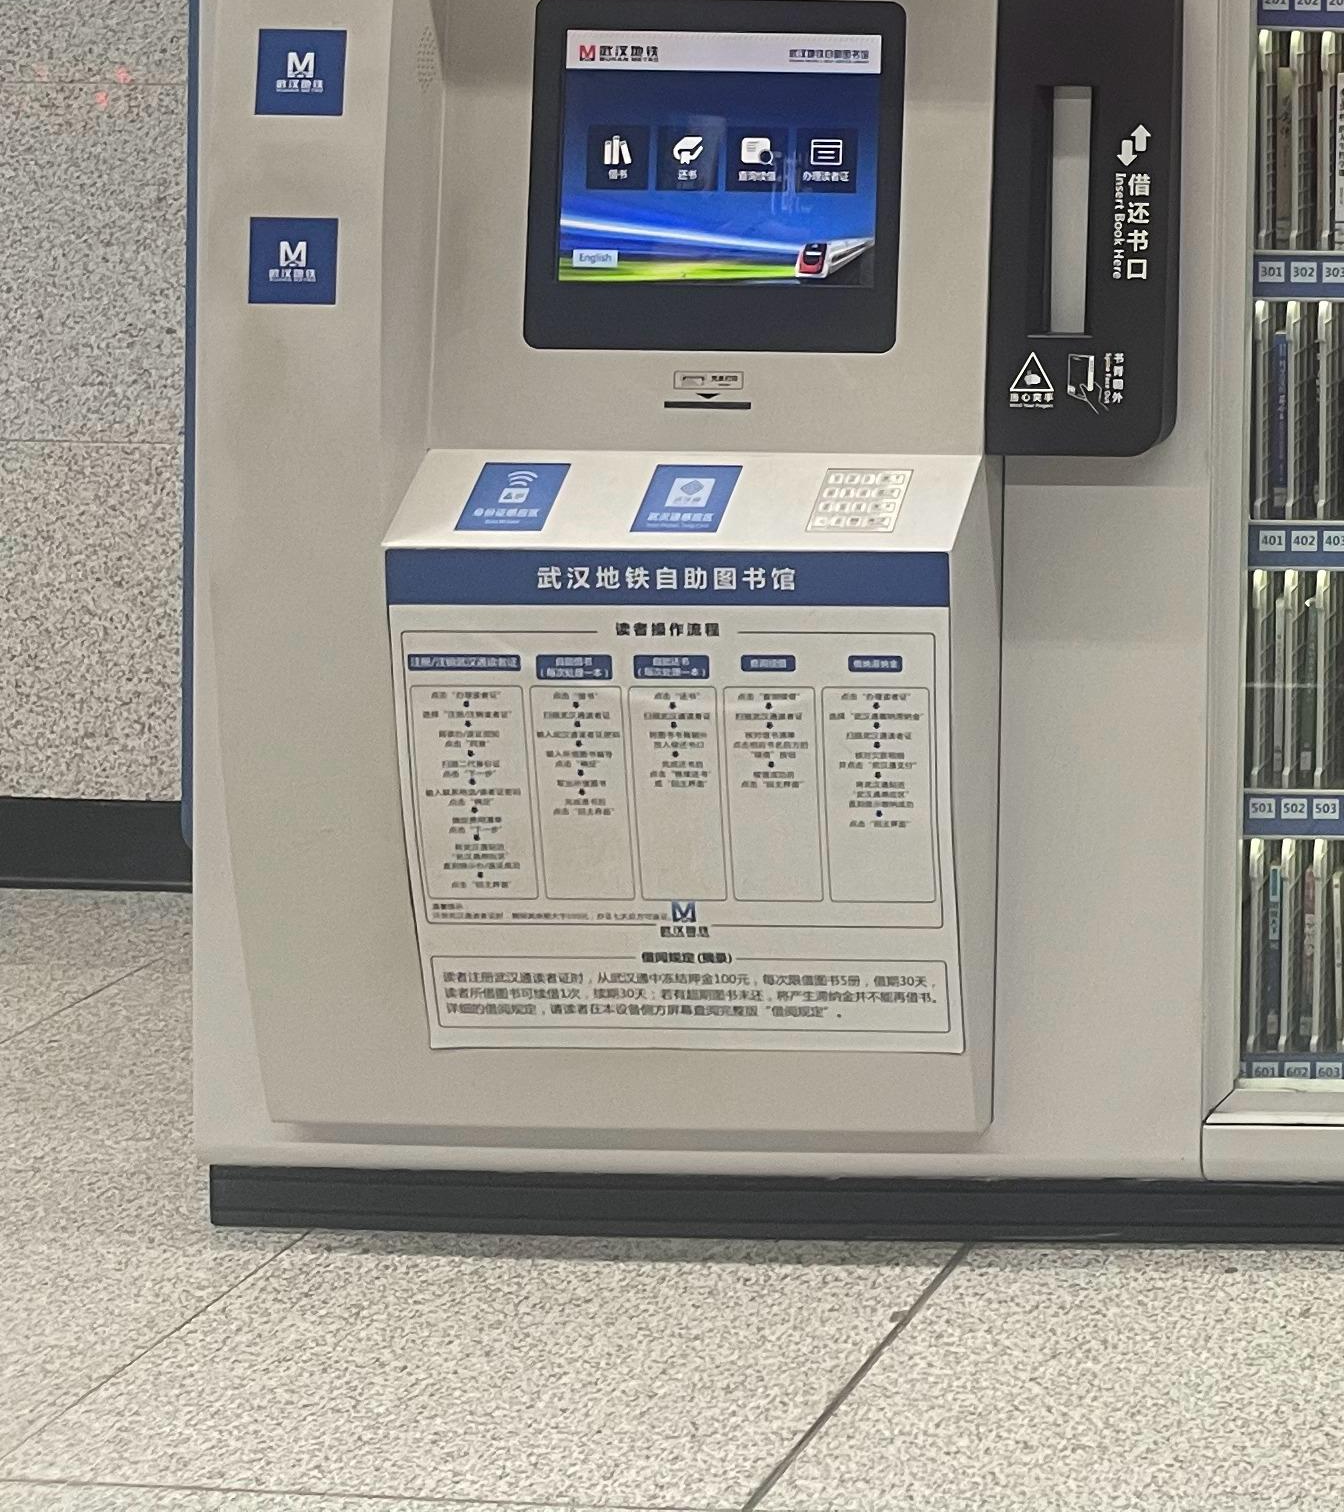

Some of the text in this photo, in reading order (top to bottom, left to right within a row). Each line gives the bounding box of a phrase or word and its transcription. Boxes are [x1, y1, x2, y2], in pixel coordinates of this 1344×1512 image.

[1112, 172, 1127, 280] Insert Book Here
[1127, 173, 1151, 280] 借还书口
[578, 252, 613, 265] English
[1261, 266, 1281, 277] 301
[1262, 535, 1282, 545] 401
[536, 565, 798, 592] 武汉地铁自助图书馆
[1251, 802, 1273, 813] 501
[1254, 1066, 1276, 1077] 601
